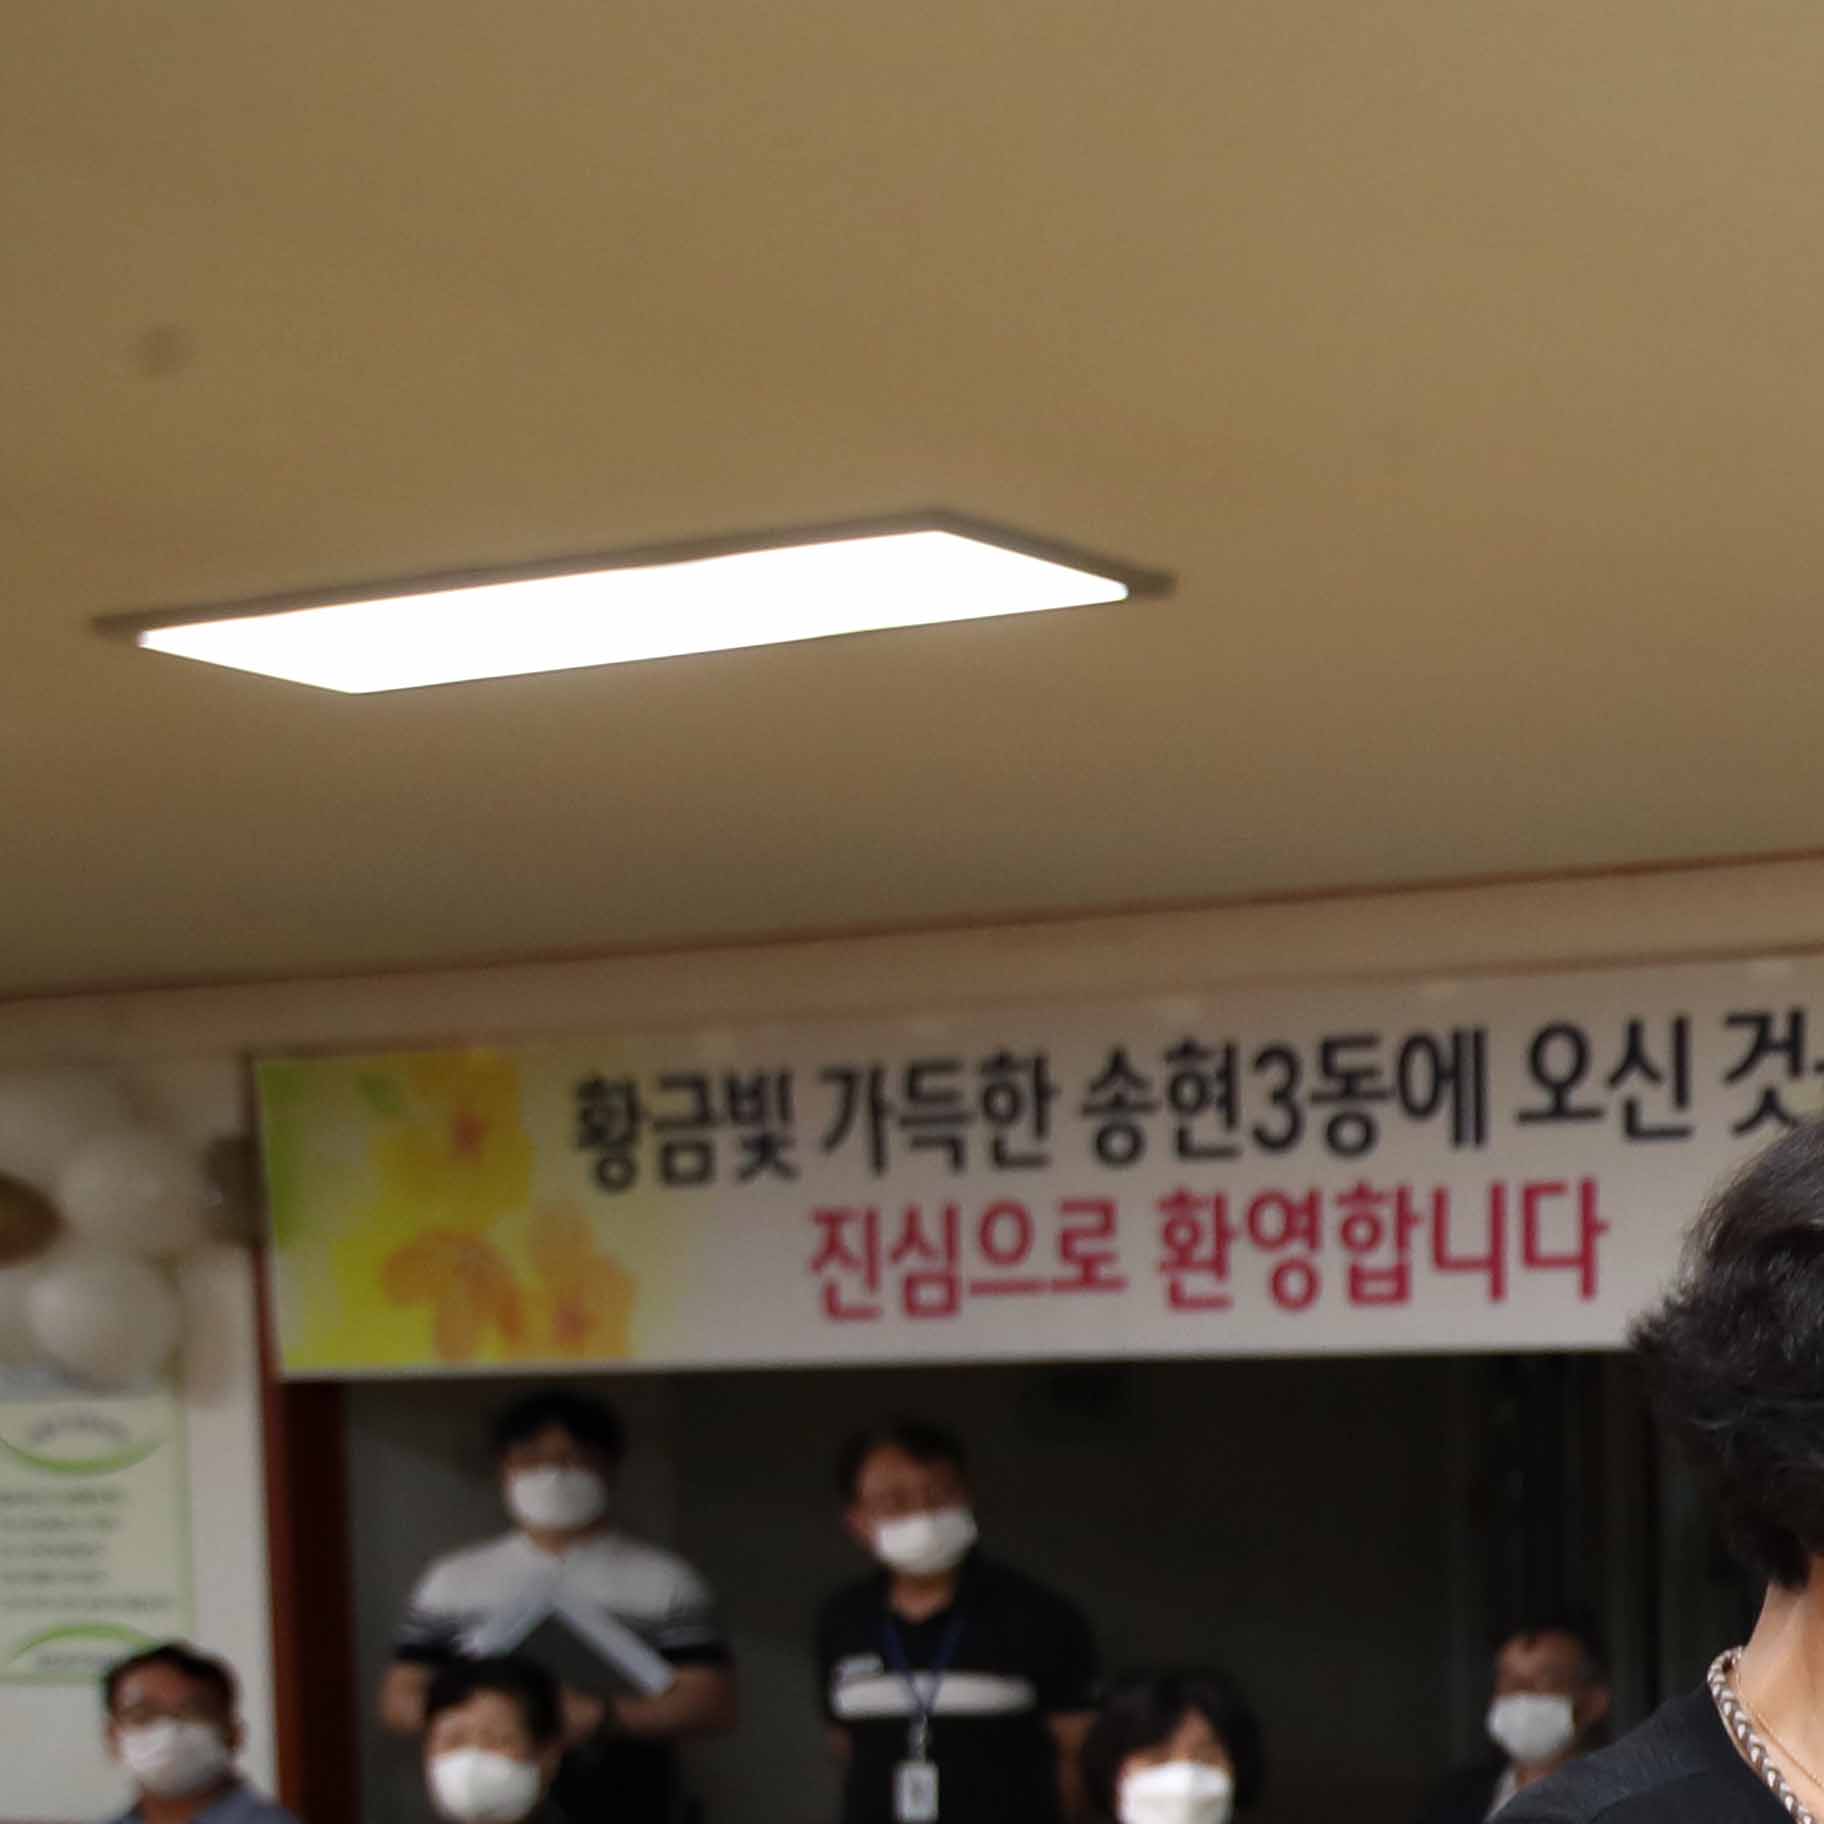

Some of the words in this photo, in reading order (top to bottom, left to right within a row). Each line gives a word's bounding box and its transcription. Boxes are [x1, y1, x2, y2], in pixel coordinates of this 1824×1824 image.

[574, 1066, 798, 1192] 황금빛
[819, 1050, 1056, 1178] 가득한
[1082, 1021, 1488, 1169] 송현3동에
[1515, 1015, 1693, 1142] 오신
[808, 1198, 1127, 1323] 진심으로
[1157, 1175, 1608, 1312] 환영합니다
